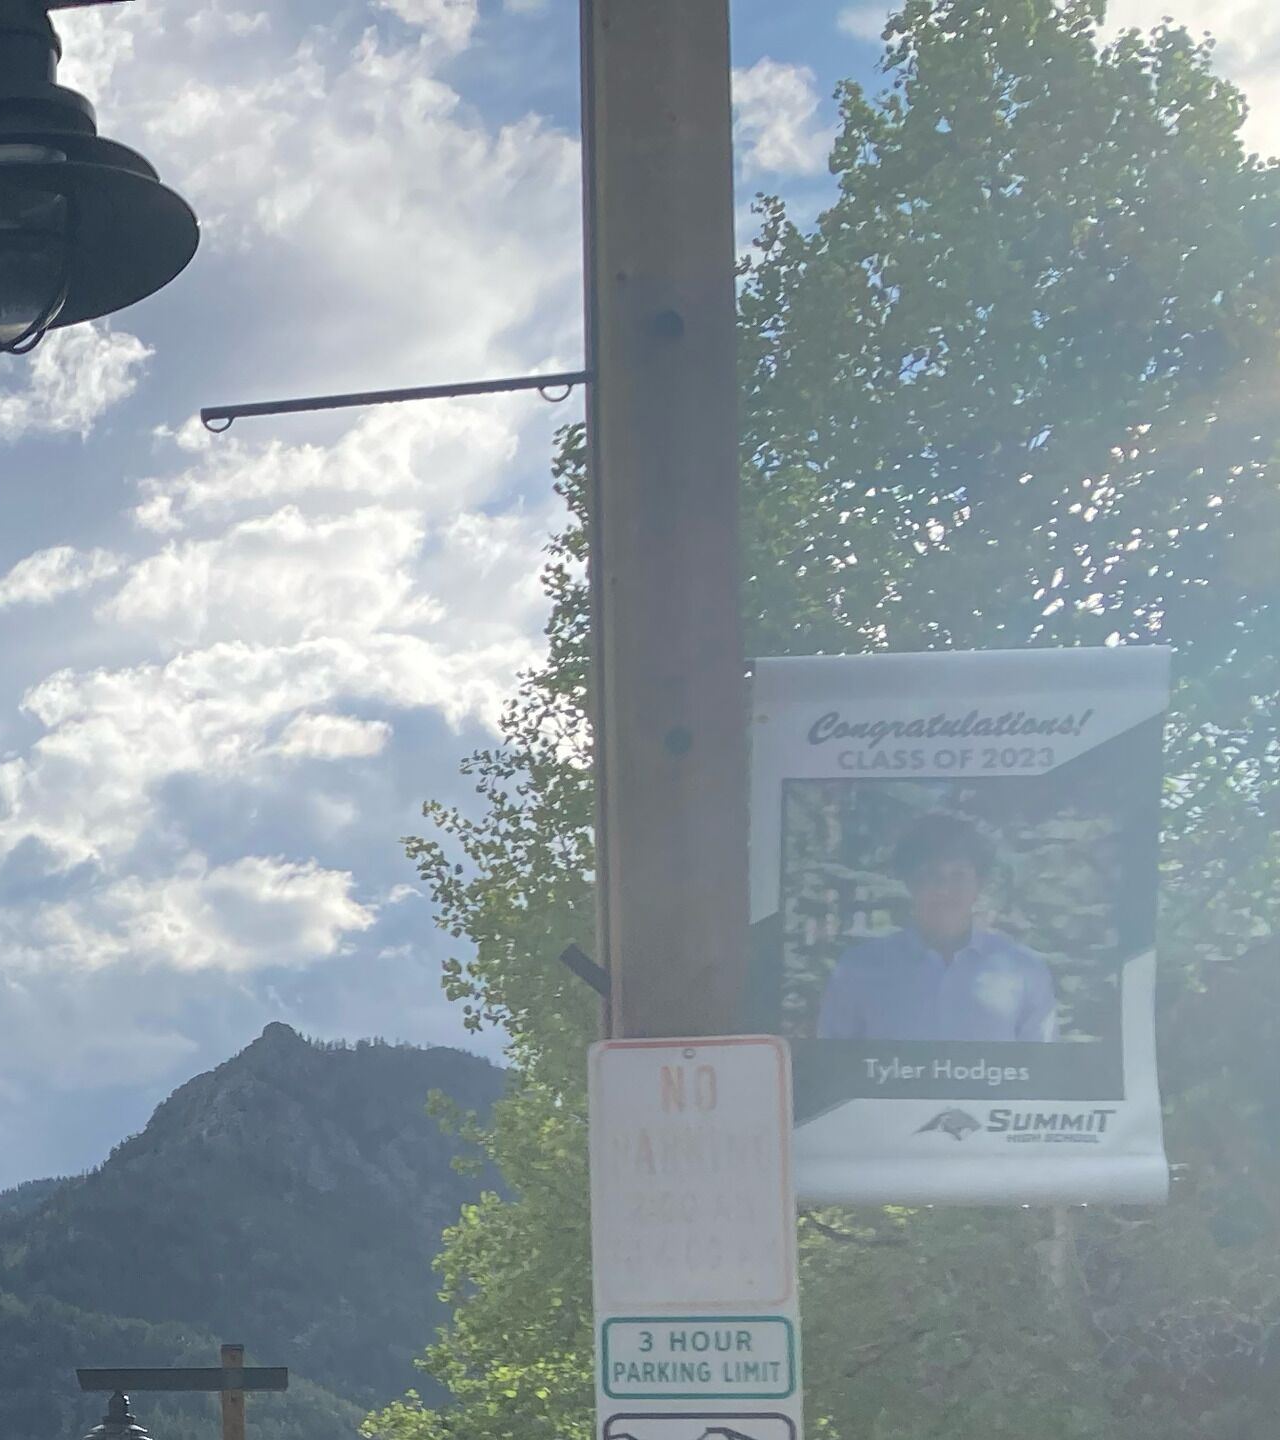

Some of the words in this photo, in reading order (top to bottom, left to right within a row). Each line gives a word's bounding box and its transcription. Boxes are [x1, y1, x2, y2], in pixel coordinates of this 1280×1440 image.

[807, 708, 1095, 749] Congratulations!
[837, 750, 926, 771] CLASS
[934, 749, 975, 771] OF
[982, 747, 1055, 769] 2023
[863, 1057, 926, 1085] Tyler
[932, 1058, 1030, 1086] Hodges
[660, 1064, 718, 1113] NO
[638, 1331, 654, 1352] 3
[669, 1330, 753, 1352] HOUR
[613, 1361, 712, 1383] PARKING
[722, 1361, 781, 1383] LIMIT
